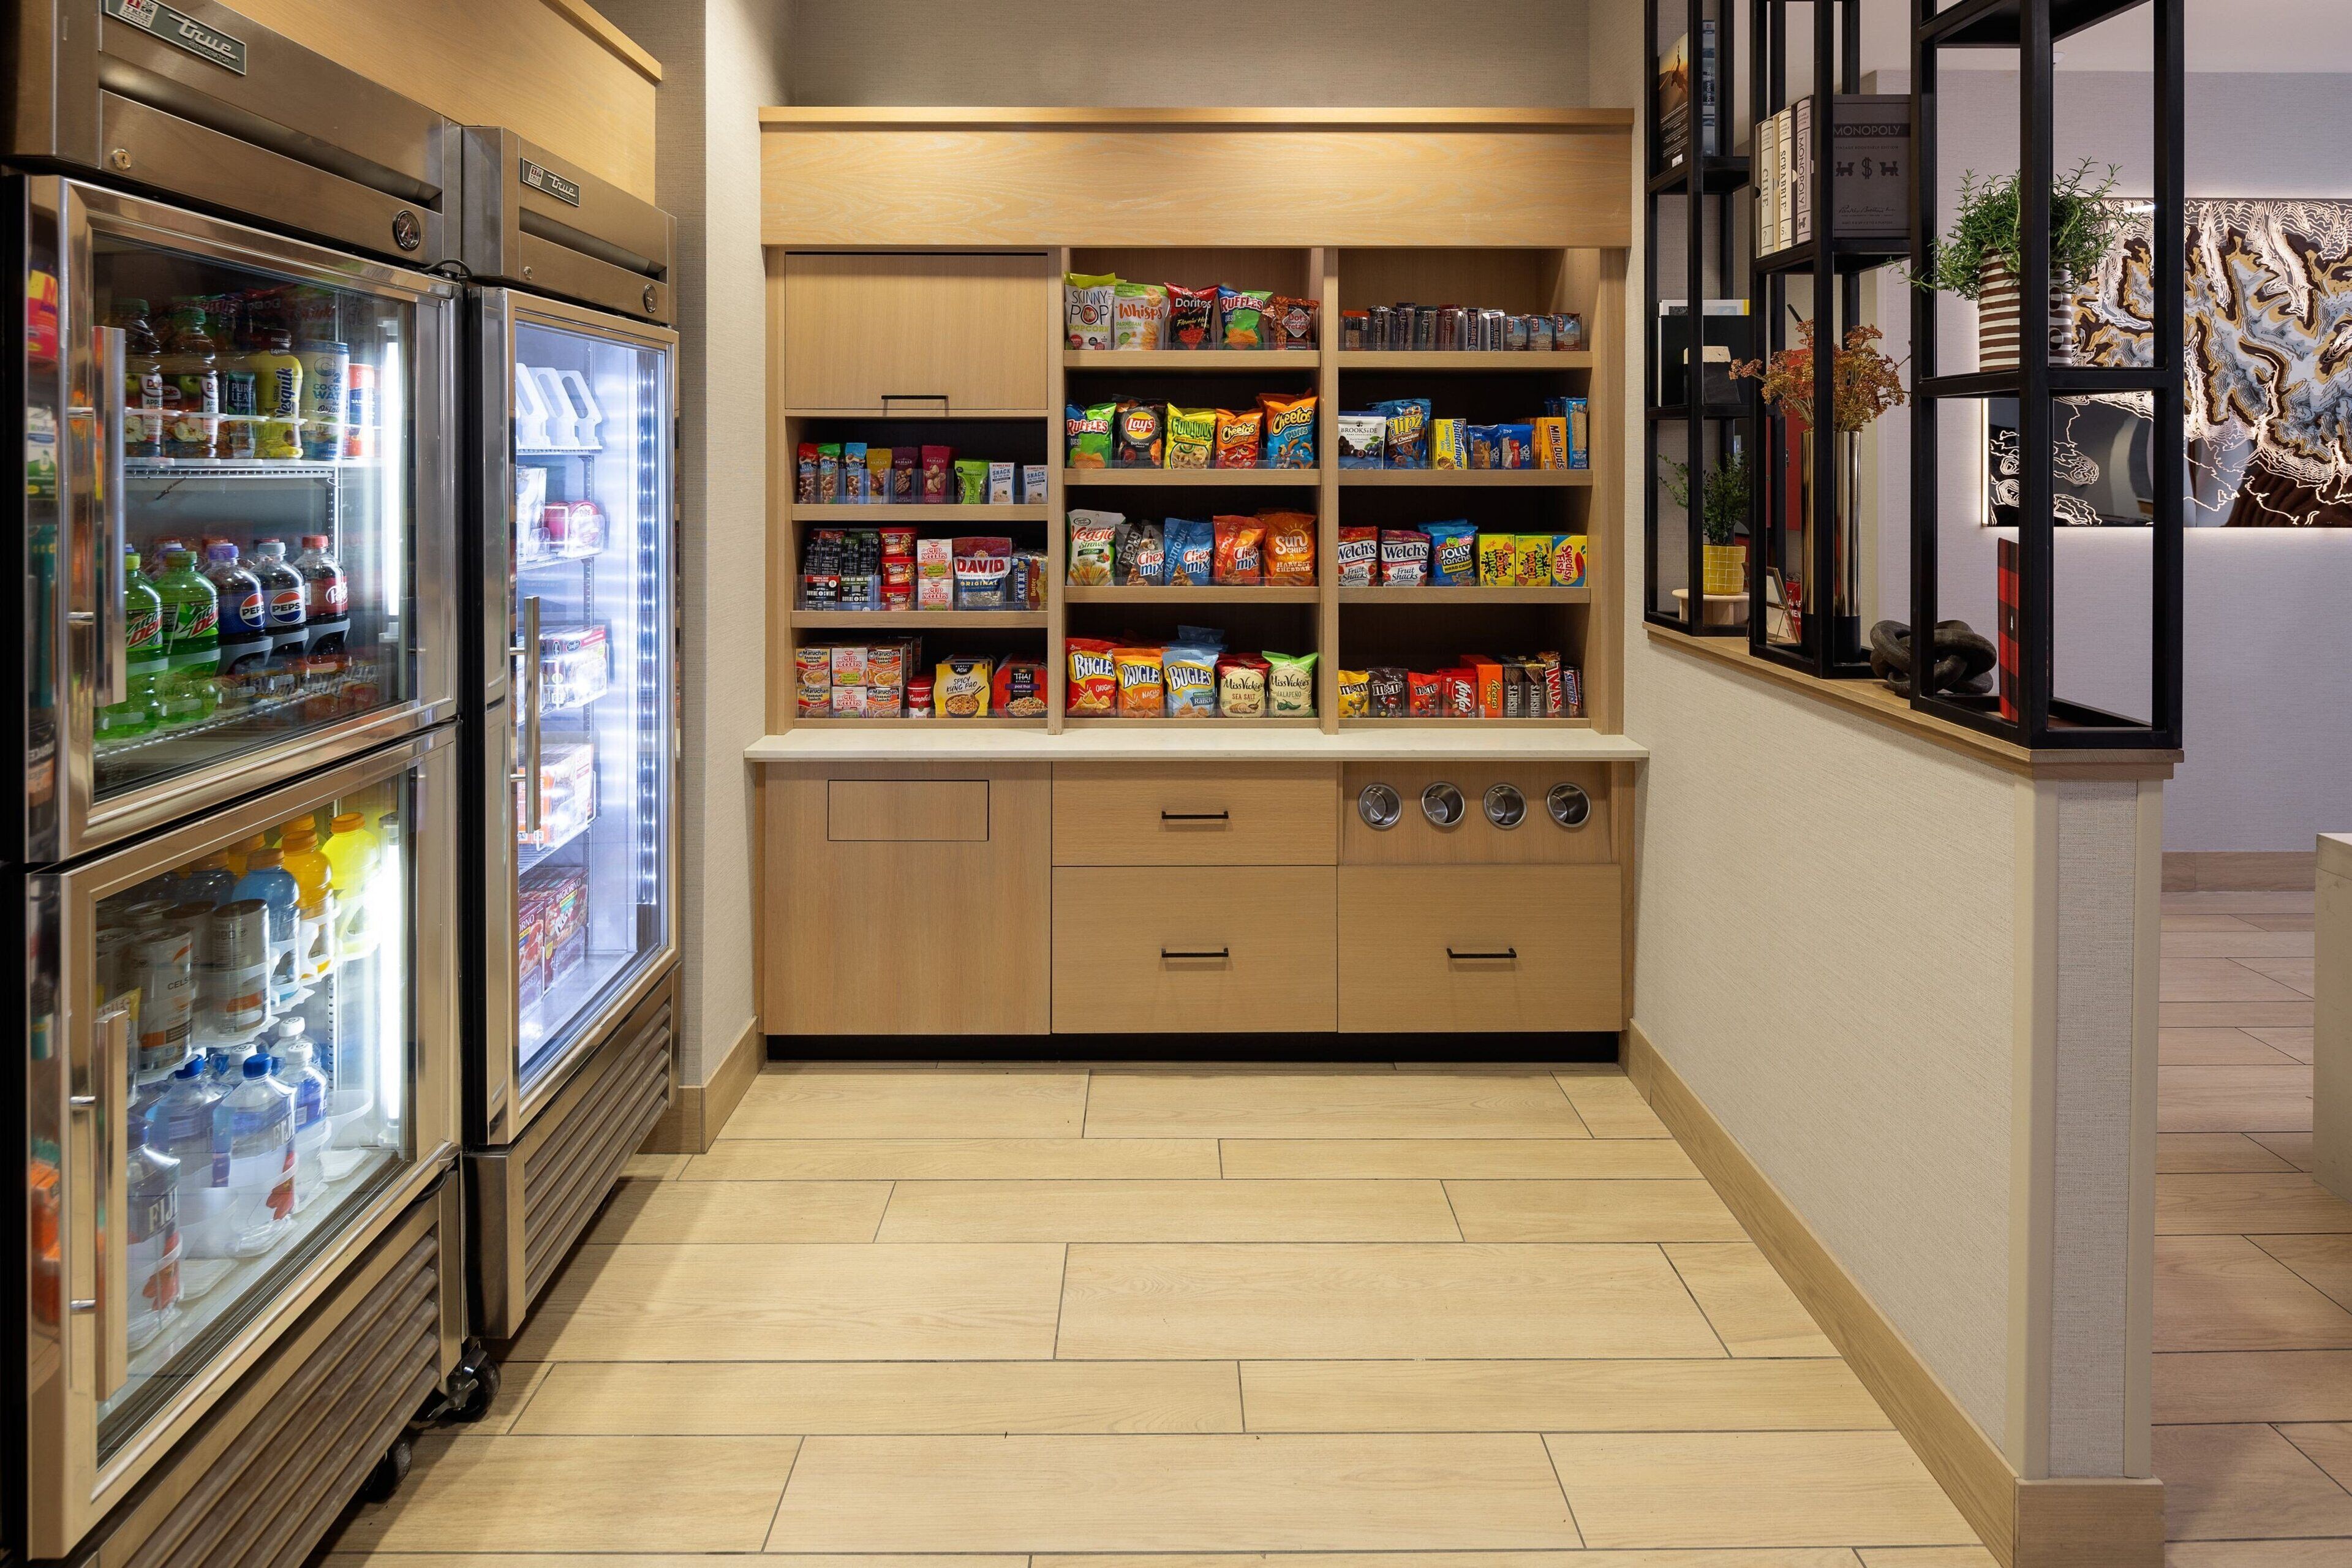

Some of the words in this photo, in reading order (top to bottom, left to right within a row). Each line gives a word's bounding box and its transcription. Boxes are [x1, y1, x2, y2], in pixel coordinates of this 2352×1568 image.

[187, 40, 231, 64] REFRIGERATOR
[1833, 126, 1900, 135] MONOPOLY
[1072, 290, 1108, 305] SKINNY
[1175, 298, 1212, 309] Doritos
[1219, 295, 1264, 314] RUFFLES
[1069, 304, 1109, 325] POP
[1115, 303, 1164, 320] Whisps
[232, 383, 254, 393] PURE
[232, 392, 255, 402] LEAF
[276, 368, 294, 418] Nesquik
[1066, 419, 1109, 435] RUFFLES
[1127, 418, 1155, 432] Lay's
[1172, 417, 1215, 440] FUNYUNS
[1272, 407, 1314, 435] Cheetos
[1221, 423, 1256, 442] Cheetos
[1453, 420, 1463, 469] Butterfinger
[1072, 526, 1115, 541] Veggie
[1275, 530, 1308, 554] Sun
[1079, 540, 1105, 549] Straws
[1123, 531, 1139, 561] BOLD
[1164, 529, 1188, 578] TRADITIONAL
[1216, 523, 1238, 567] CHEDDAR
[1234, 546, 1259, 560] Chex
[1338, 543, 1376, 560] Welch's
[1383, 545, 1427, 559] Welch's
[1440, 545, 1470, 559] JOLLY
[1137, 551, 1164, 566] Chex
[1183, 548, 1212, 564] Chex
[1236, 554, 1259, 571] mix
[1488, 551, 1498, 577] SOUR
[1496, 549, 1506, 577] PATCH
[1528, 551, 1536, 578] PATCH
[1535, 551, 1544, 577] SOUR
[1555, 554, 1566, 575] Fish
[1562, 545, 1575, 581] Swedish
[957, 559, 1005, 573] DAVID
[1140, 560, 1164, 576] mix
[1186, 559, 1210, 575] mix
[1342, 572, 1368, 582] Snacks
[1392, 573, 1418, 581] Snacks
[1072, 654, 1115, 680] BUGLES
[953, 676, 971, 685] SPICY
[1120, 664, 1160, 689] BUGLES
[1167, 666, 1212, 692] BUGLES
[1223, 677, 1242, 690] Miss
[1270, 674, 1287, 687] Miss
[1284, 674, 1310, 690] Vickie's
[946, 684, 963, 693] KUNG
[965, 681, 978, 690] PAO
[1142, 689, 1160, 699] NACHO
[1491, 679, 1501, 710] Reese's
[1545, 663, 1562, 713] TWIX
[1564, 671, 1577, 704] SNICKERS
[556, 878, 581, 902] DIGIORNO
[272, 1115, 294, 1152] FIJI
[148, 1186, 179, 1236] FIJI
